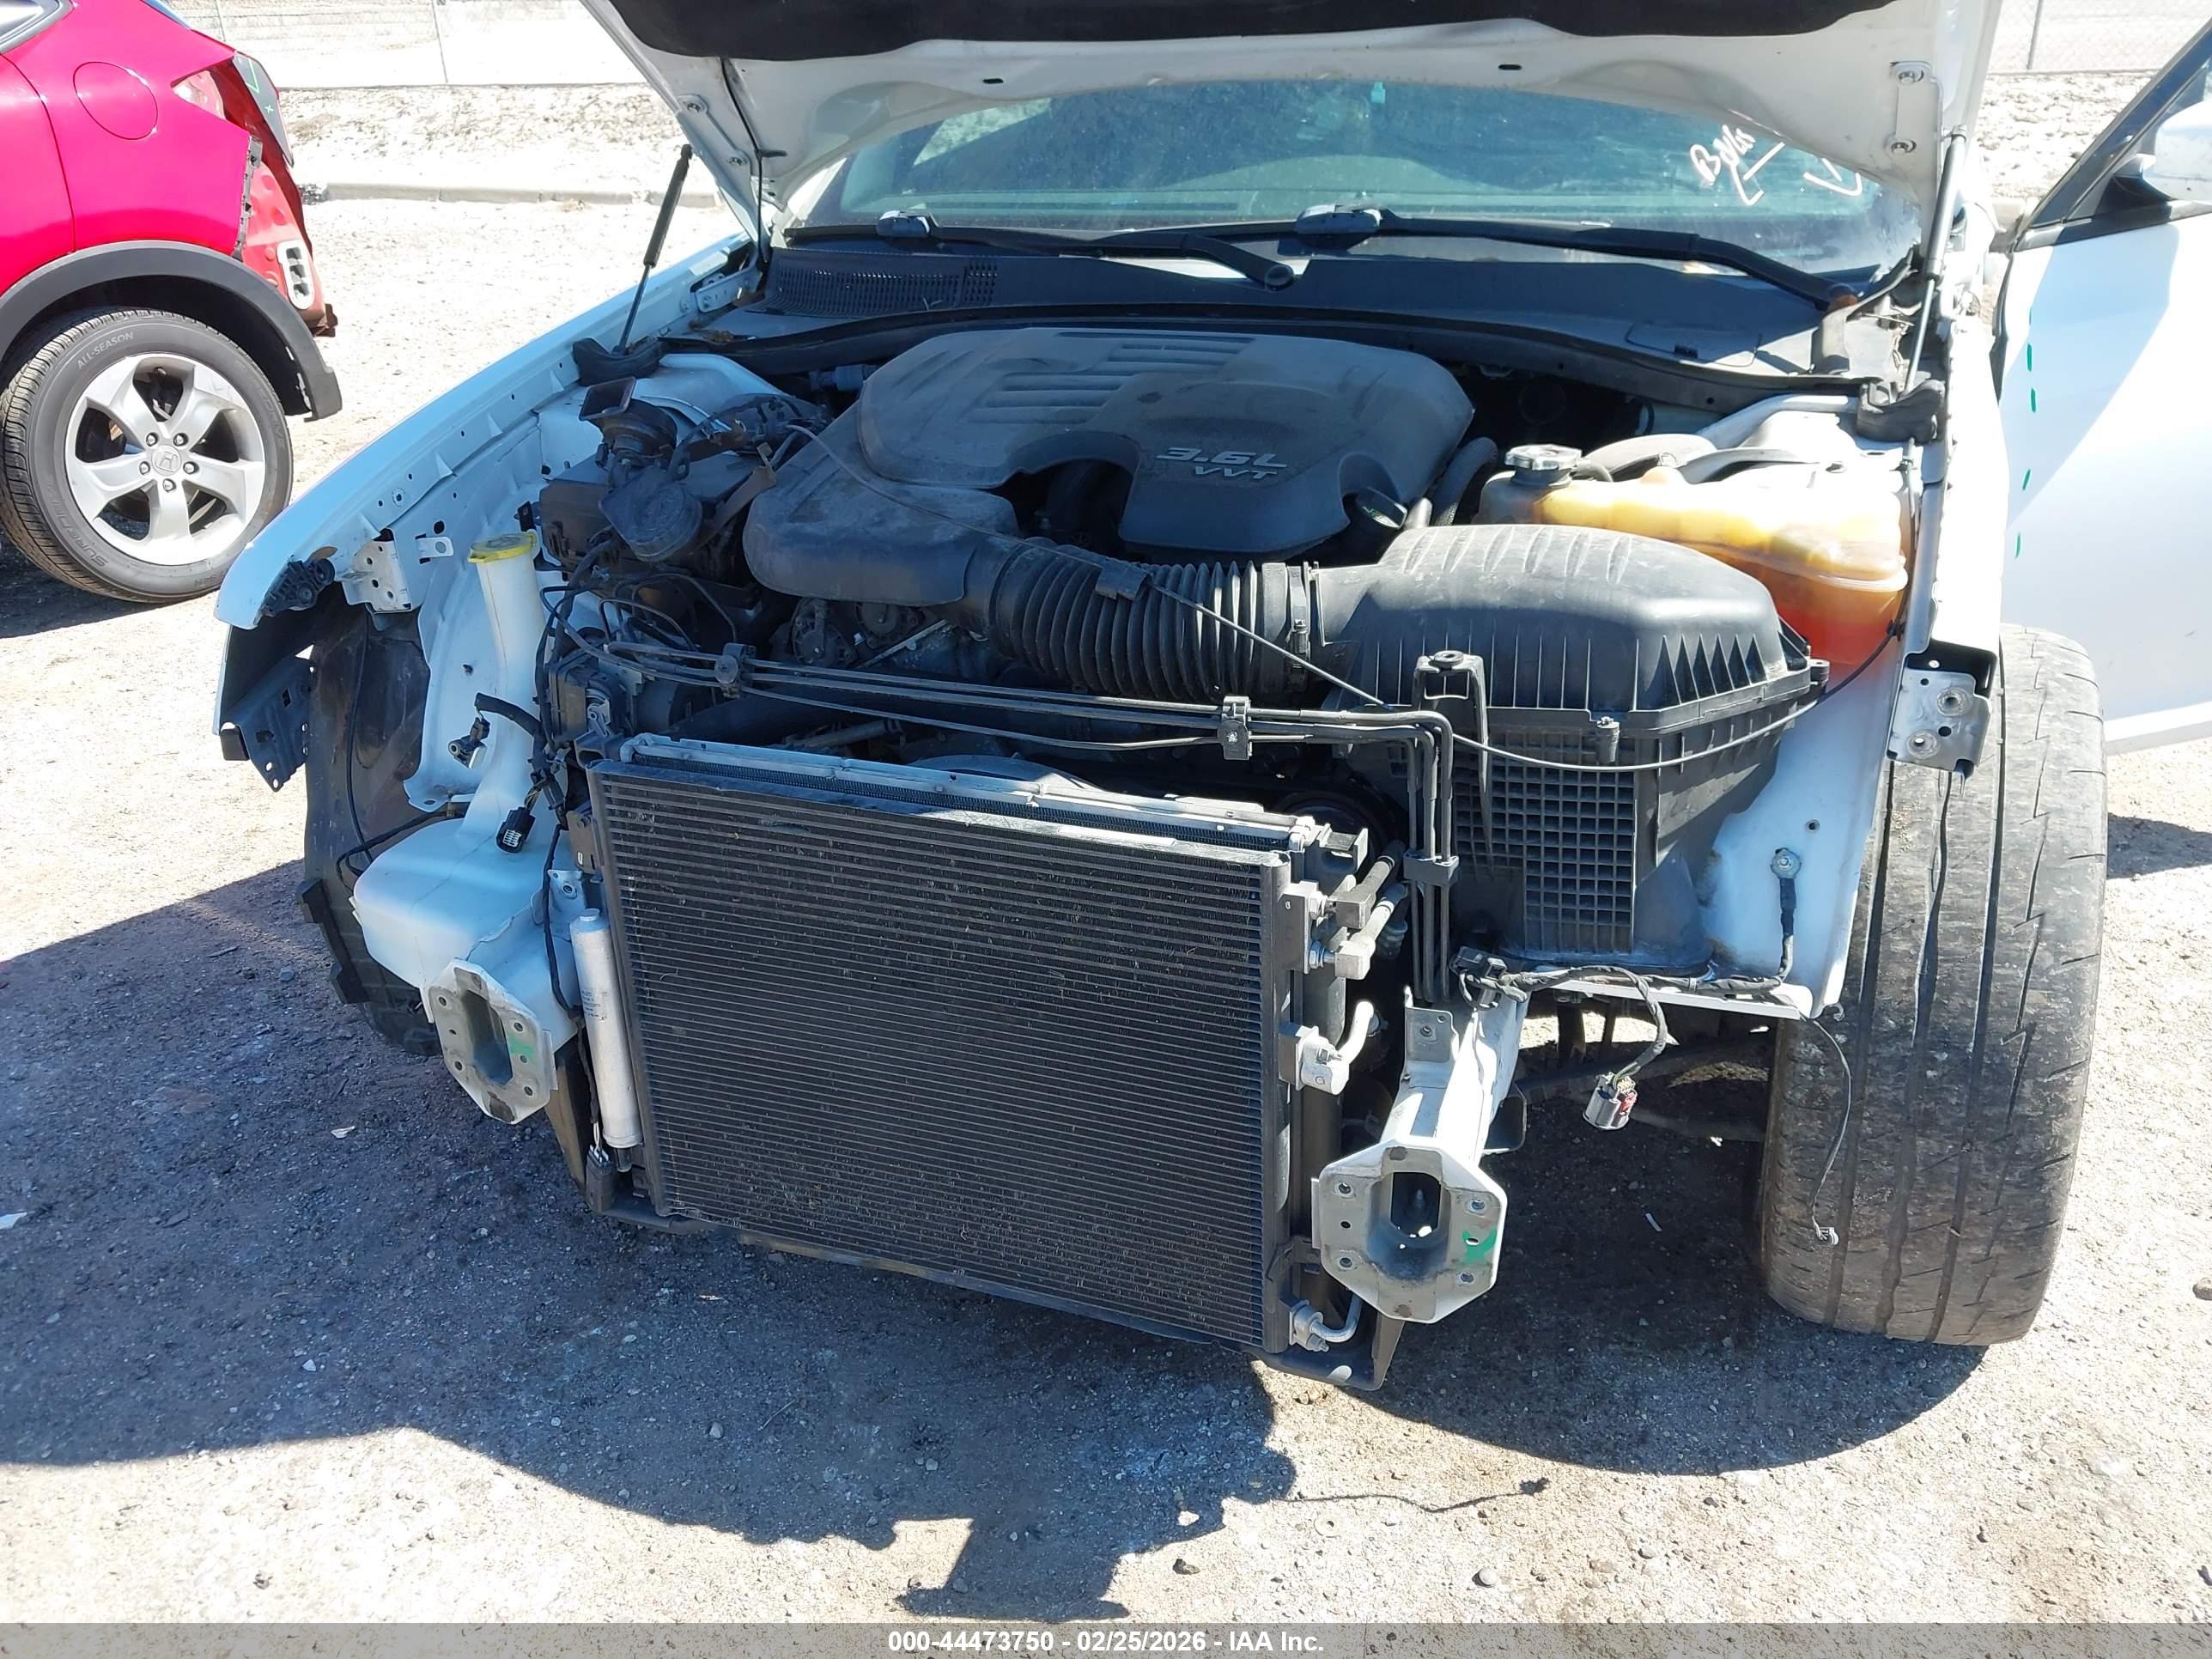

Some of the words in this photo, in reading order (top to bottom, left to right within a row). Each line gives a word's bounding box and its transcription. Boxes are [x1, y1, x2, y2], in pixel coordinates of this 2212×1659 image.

[76, 331, 134, 370] ALL-SEASON
[1156, 447, 1287, 468] 3.6L
[1195, 465, 1277, 479] VVT
